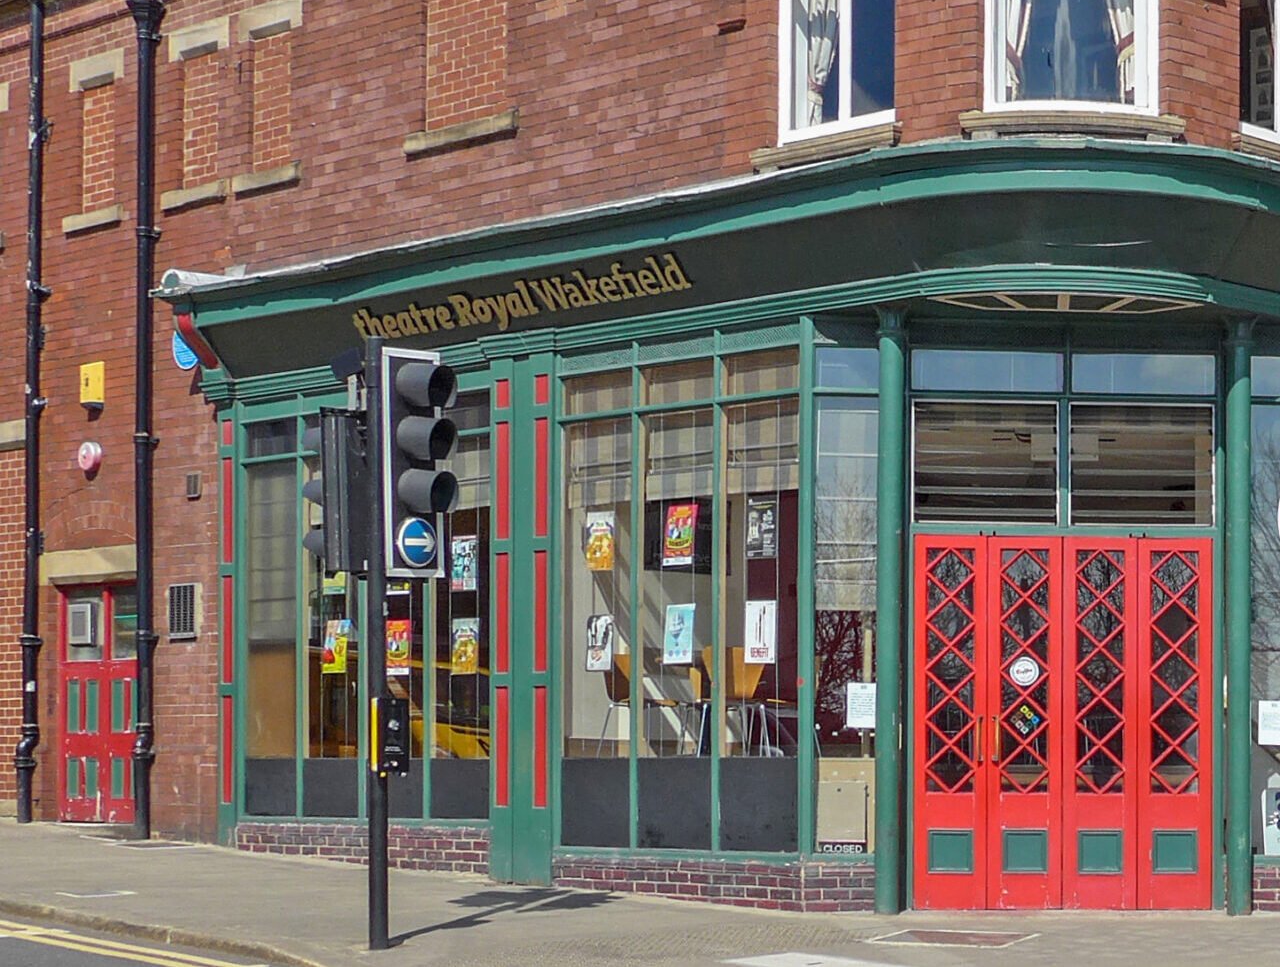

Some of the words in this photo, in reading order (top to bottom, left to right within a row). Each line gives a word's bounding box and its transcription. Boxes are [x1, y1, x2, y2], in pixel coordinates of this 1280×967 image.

[353, 302, 454, 340] theatre
[450, 280, 540, 331] Royal
[532, 252, 692, 312] Wakefield
[823, 844, 863, 854] CLOSED
